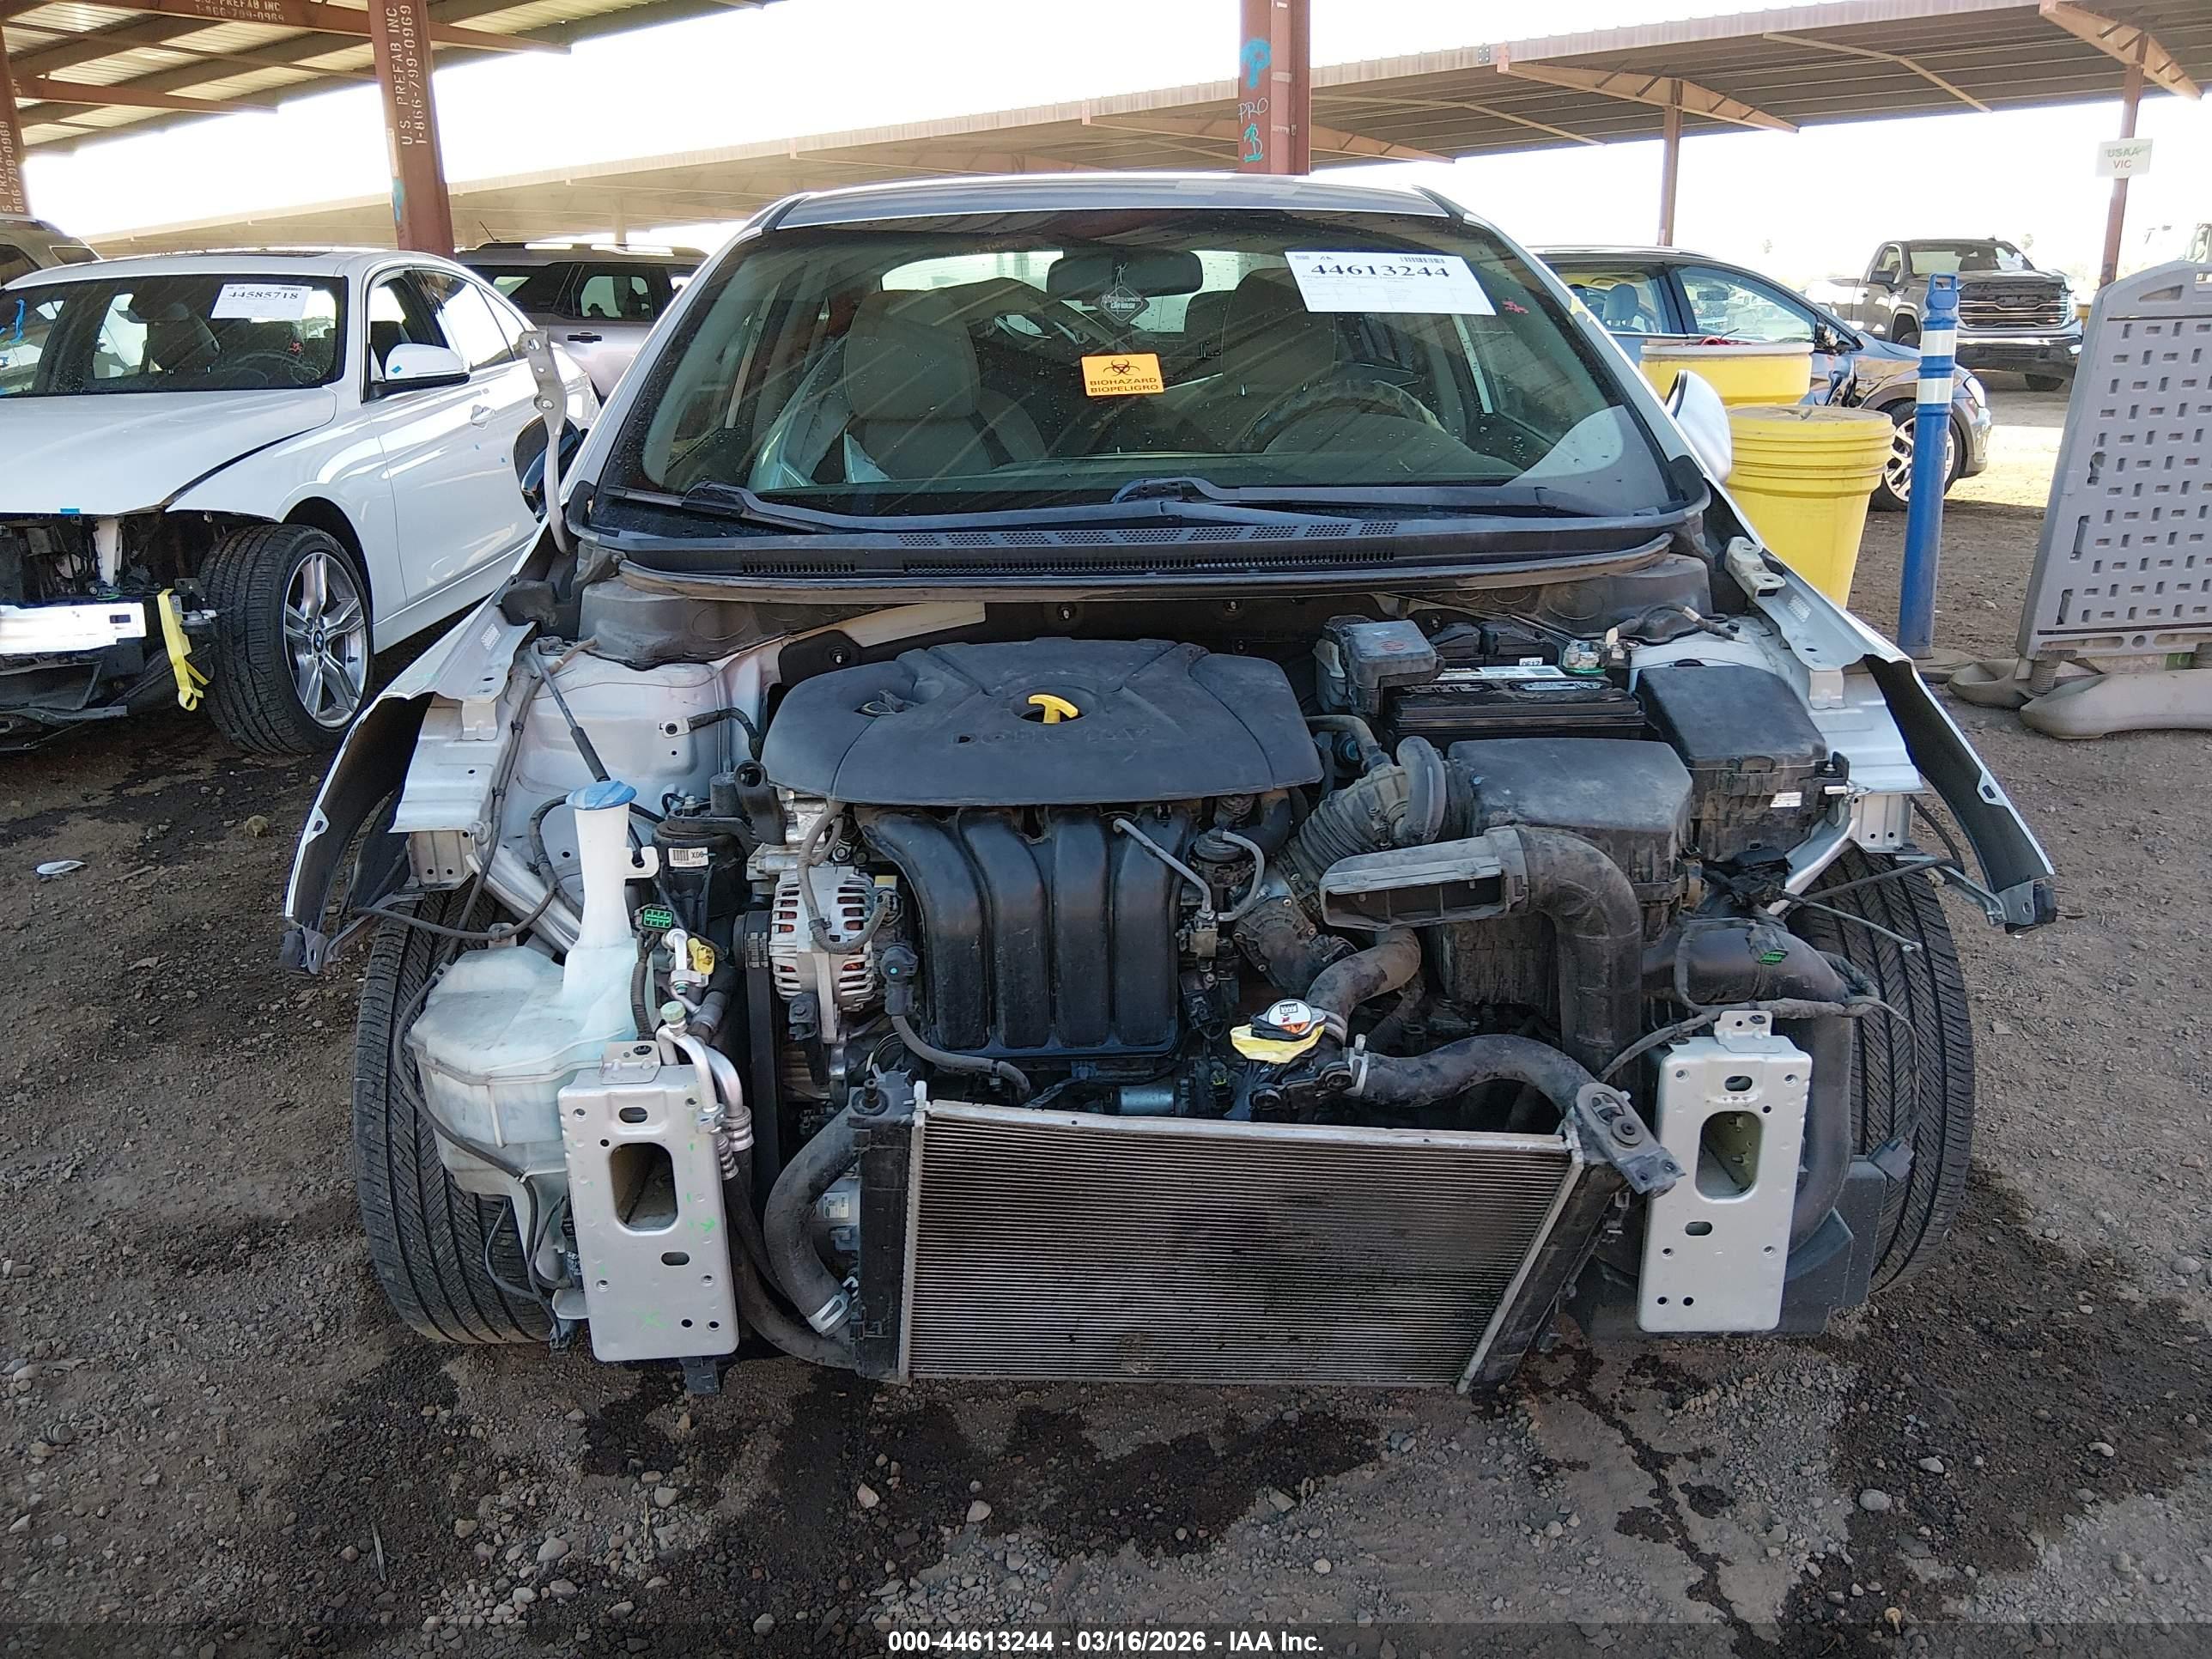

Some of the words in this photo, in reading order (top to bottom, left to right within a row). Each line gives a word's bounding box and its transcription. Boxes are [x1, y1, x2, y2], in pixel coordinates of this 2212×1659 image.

[390, 41, 409, 106] PREFAB
[399, 5, 428, 144] 1-866-799-0969
[1237, 97, 1269, 125] PRO
[398, 115, 413, 145] U.S.
[2113, 159, 2131, 168] VIC
[1311, 264, 1450, 277] 44613244
[228, 291, 299, 300] 44585718
[1091, 385, 1158, 393] BIOPELIGRO
